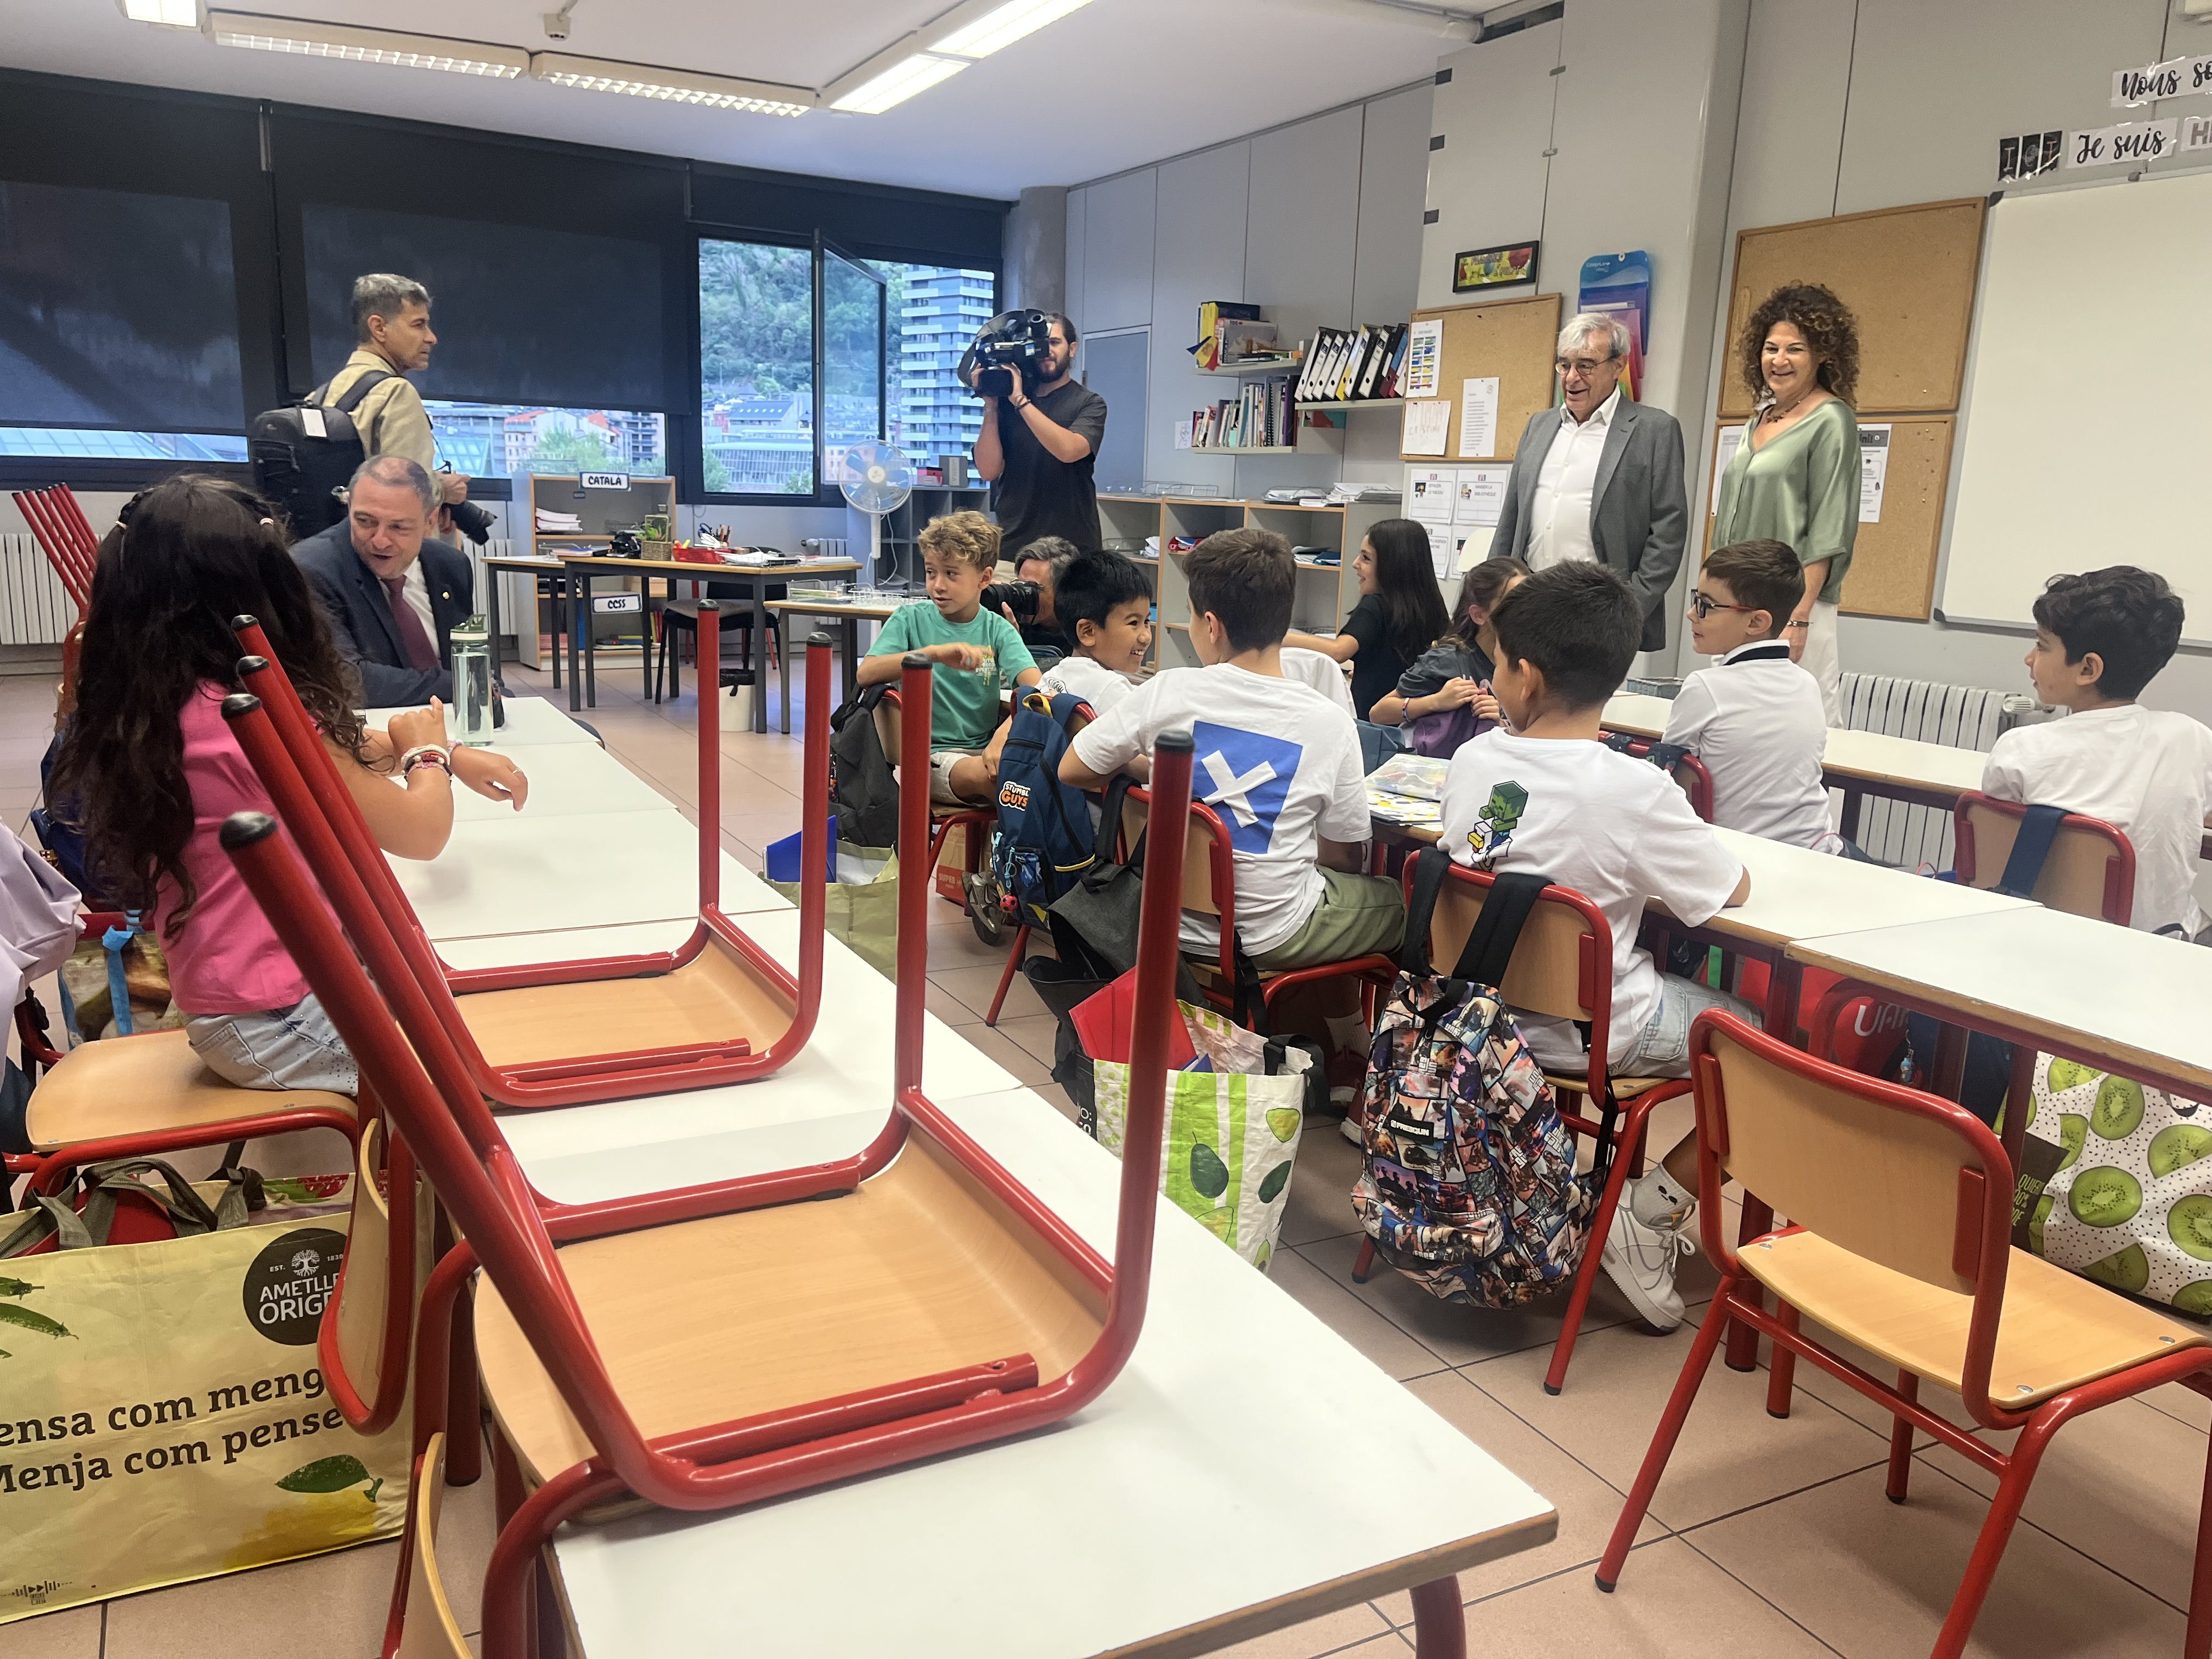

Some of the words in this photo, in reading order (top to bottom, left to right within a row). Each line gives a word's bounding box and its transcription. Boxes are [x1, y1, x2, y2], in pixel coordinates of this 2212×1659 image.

[2121, 70, 2182, 100] Nous
[2076, 134, 2105, 164] Je
[2114, 127, 2166, 160] suis
[608, 599, 625, 609] CCSS
[108, 1391, 197, 1432] com
[123, 1438, 211, 1475] com
